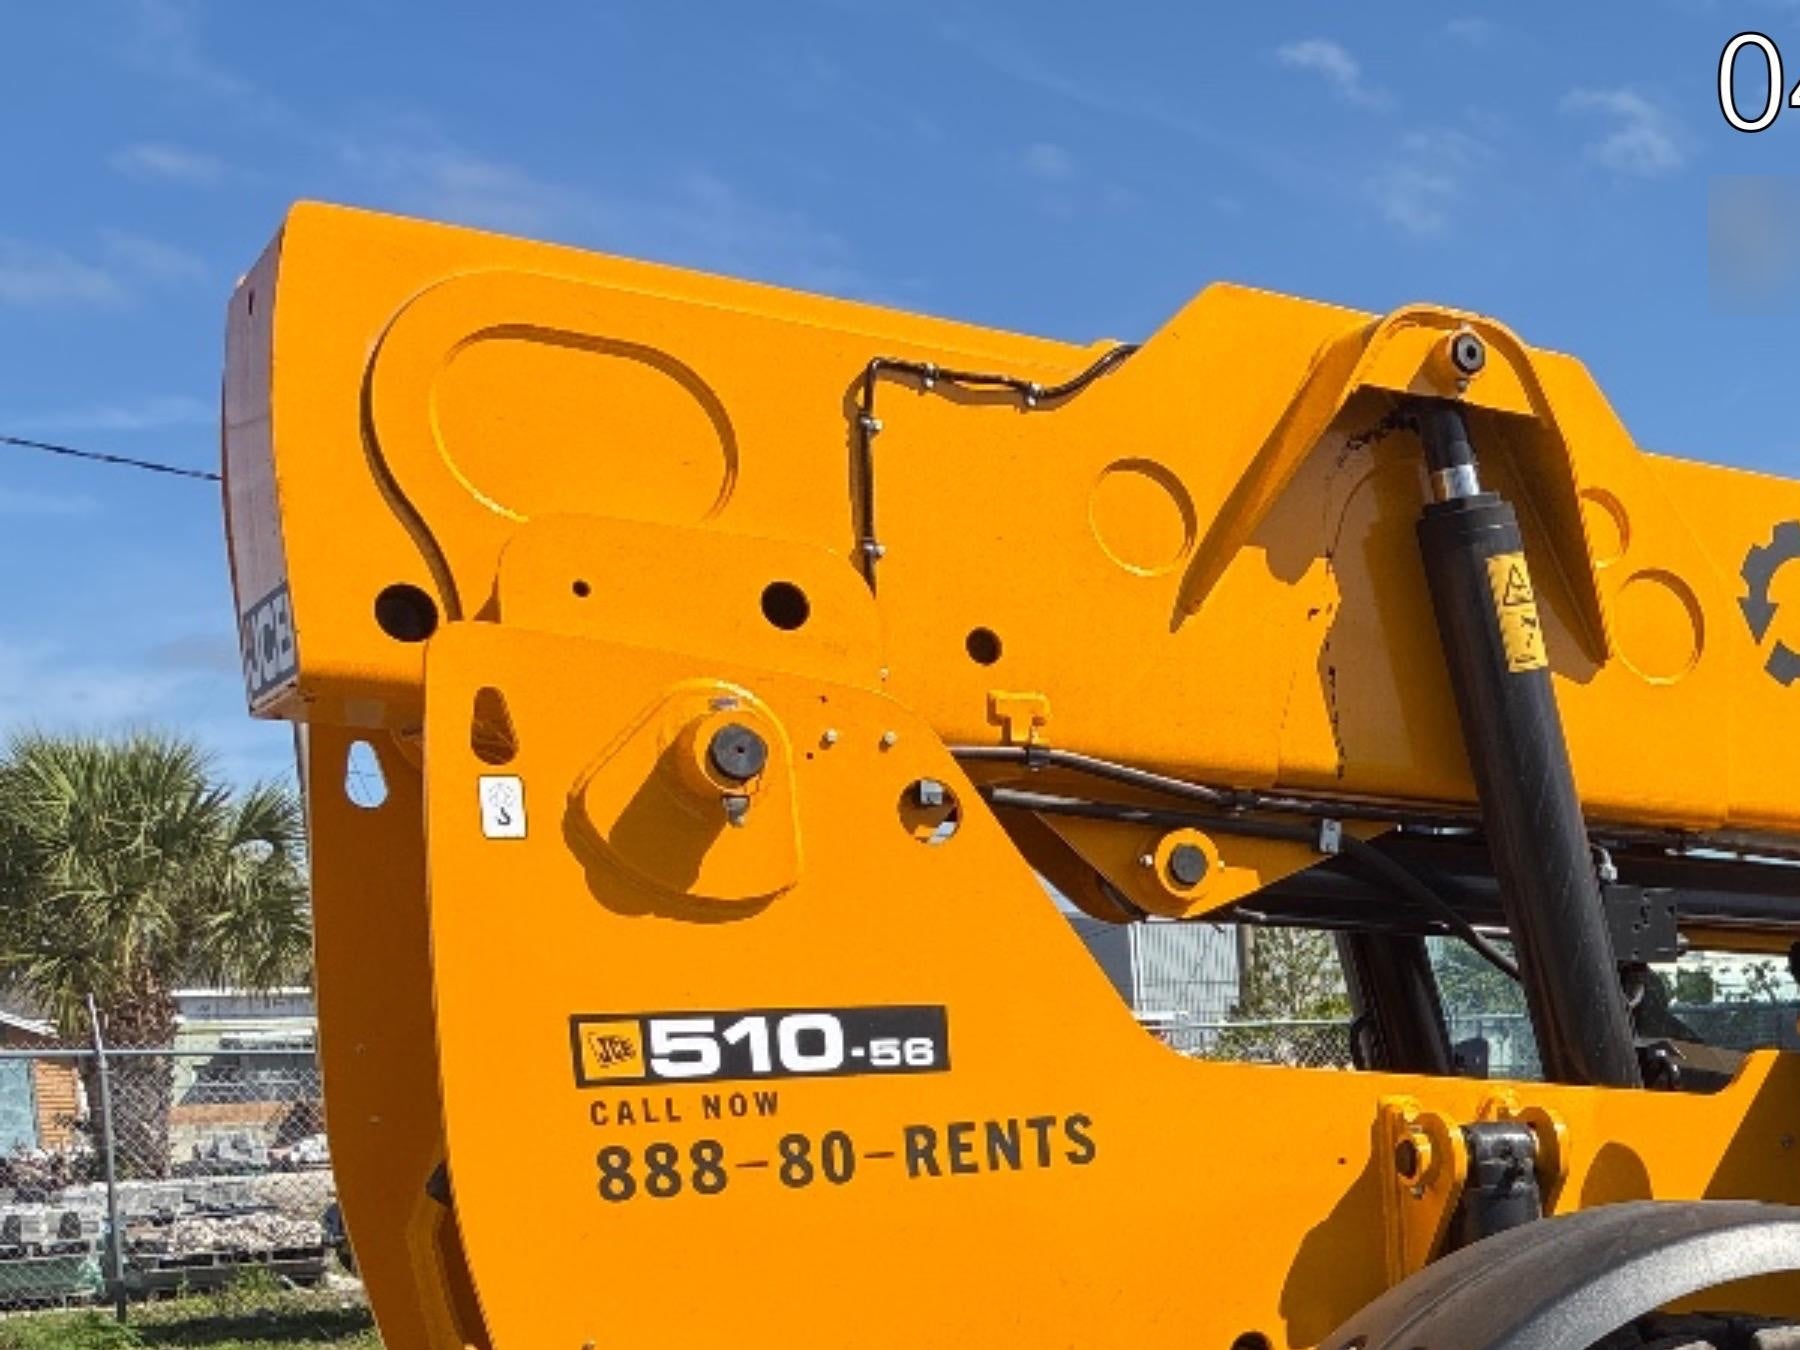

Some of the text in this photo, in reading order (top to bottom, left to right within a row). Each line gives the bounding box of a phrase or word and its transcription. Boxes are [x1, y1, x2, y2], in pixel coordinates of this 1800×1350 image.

[649, 1012, 935, 1078] 510-56
[589, 1091, 779, 1127] CALL NOW
[597, 1112, 1097, 1203] 888-80-RENTS
